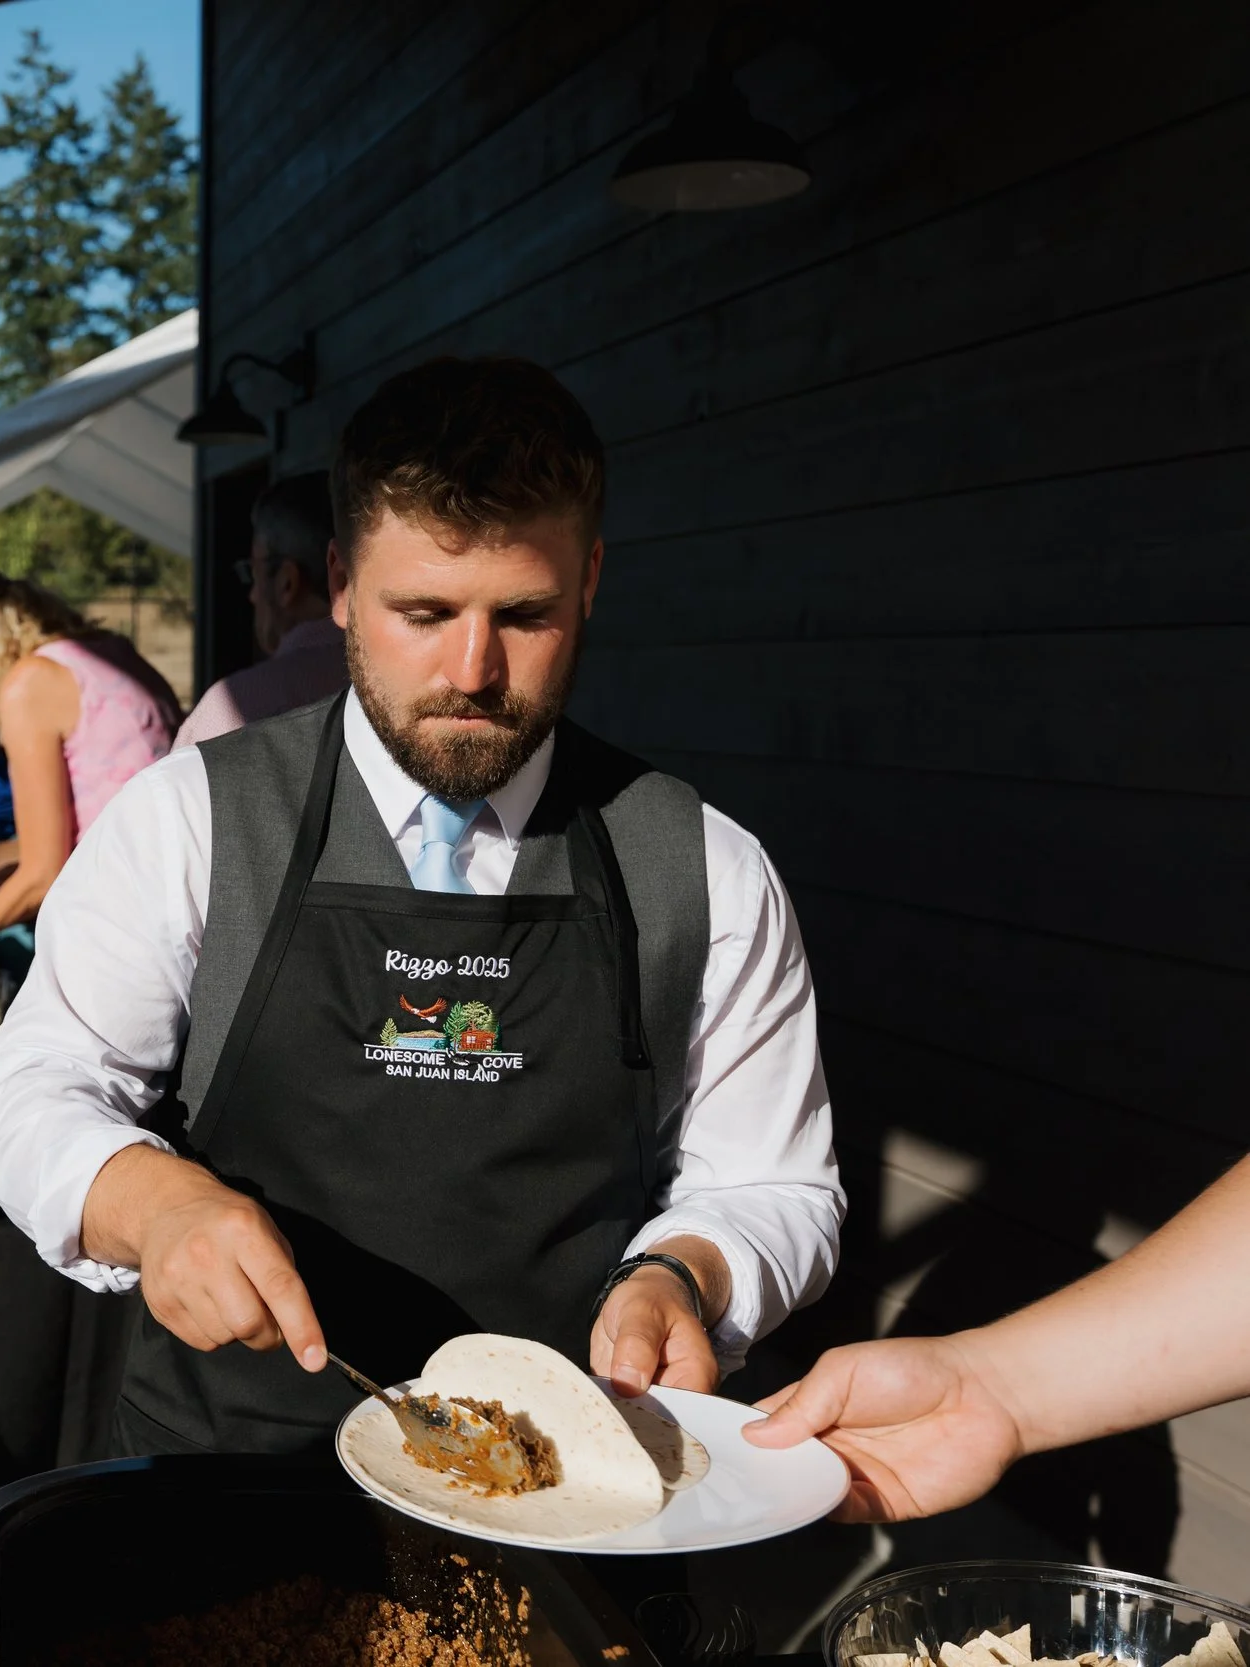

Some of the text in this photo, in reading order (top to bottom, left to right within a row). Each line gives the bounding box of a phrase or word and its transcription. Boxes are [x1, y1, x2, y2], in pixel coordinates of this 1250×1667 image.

[385, 949, 510, 980] Rizzo 2025
[365, 1047, 523, 1069] LONESOME COVE
[385, 1064, 500, 1082] SAN JUAN ISLAND
